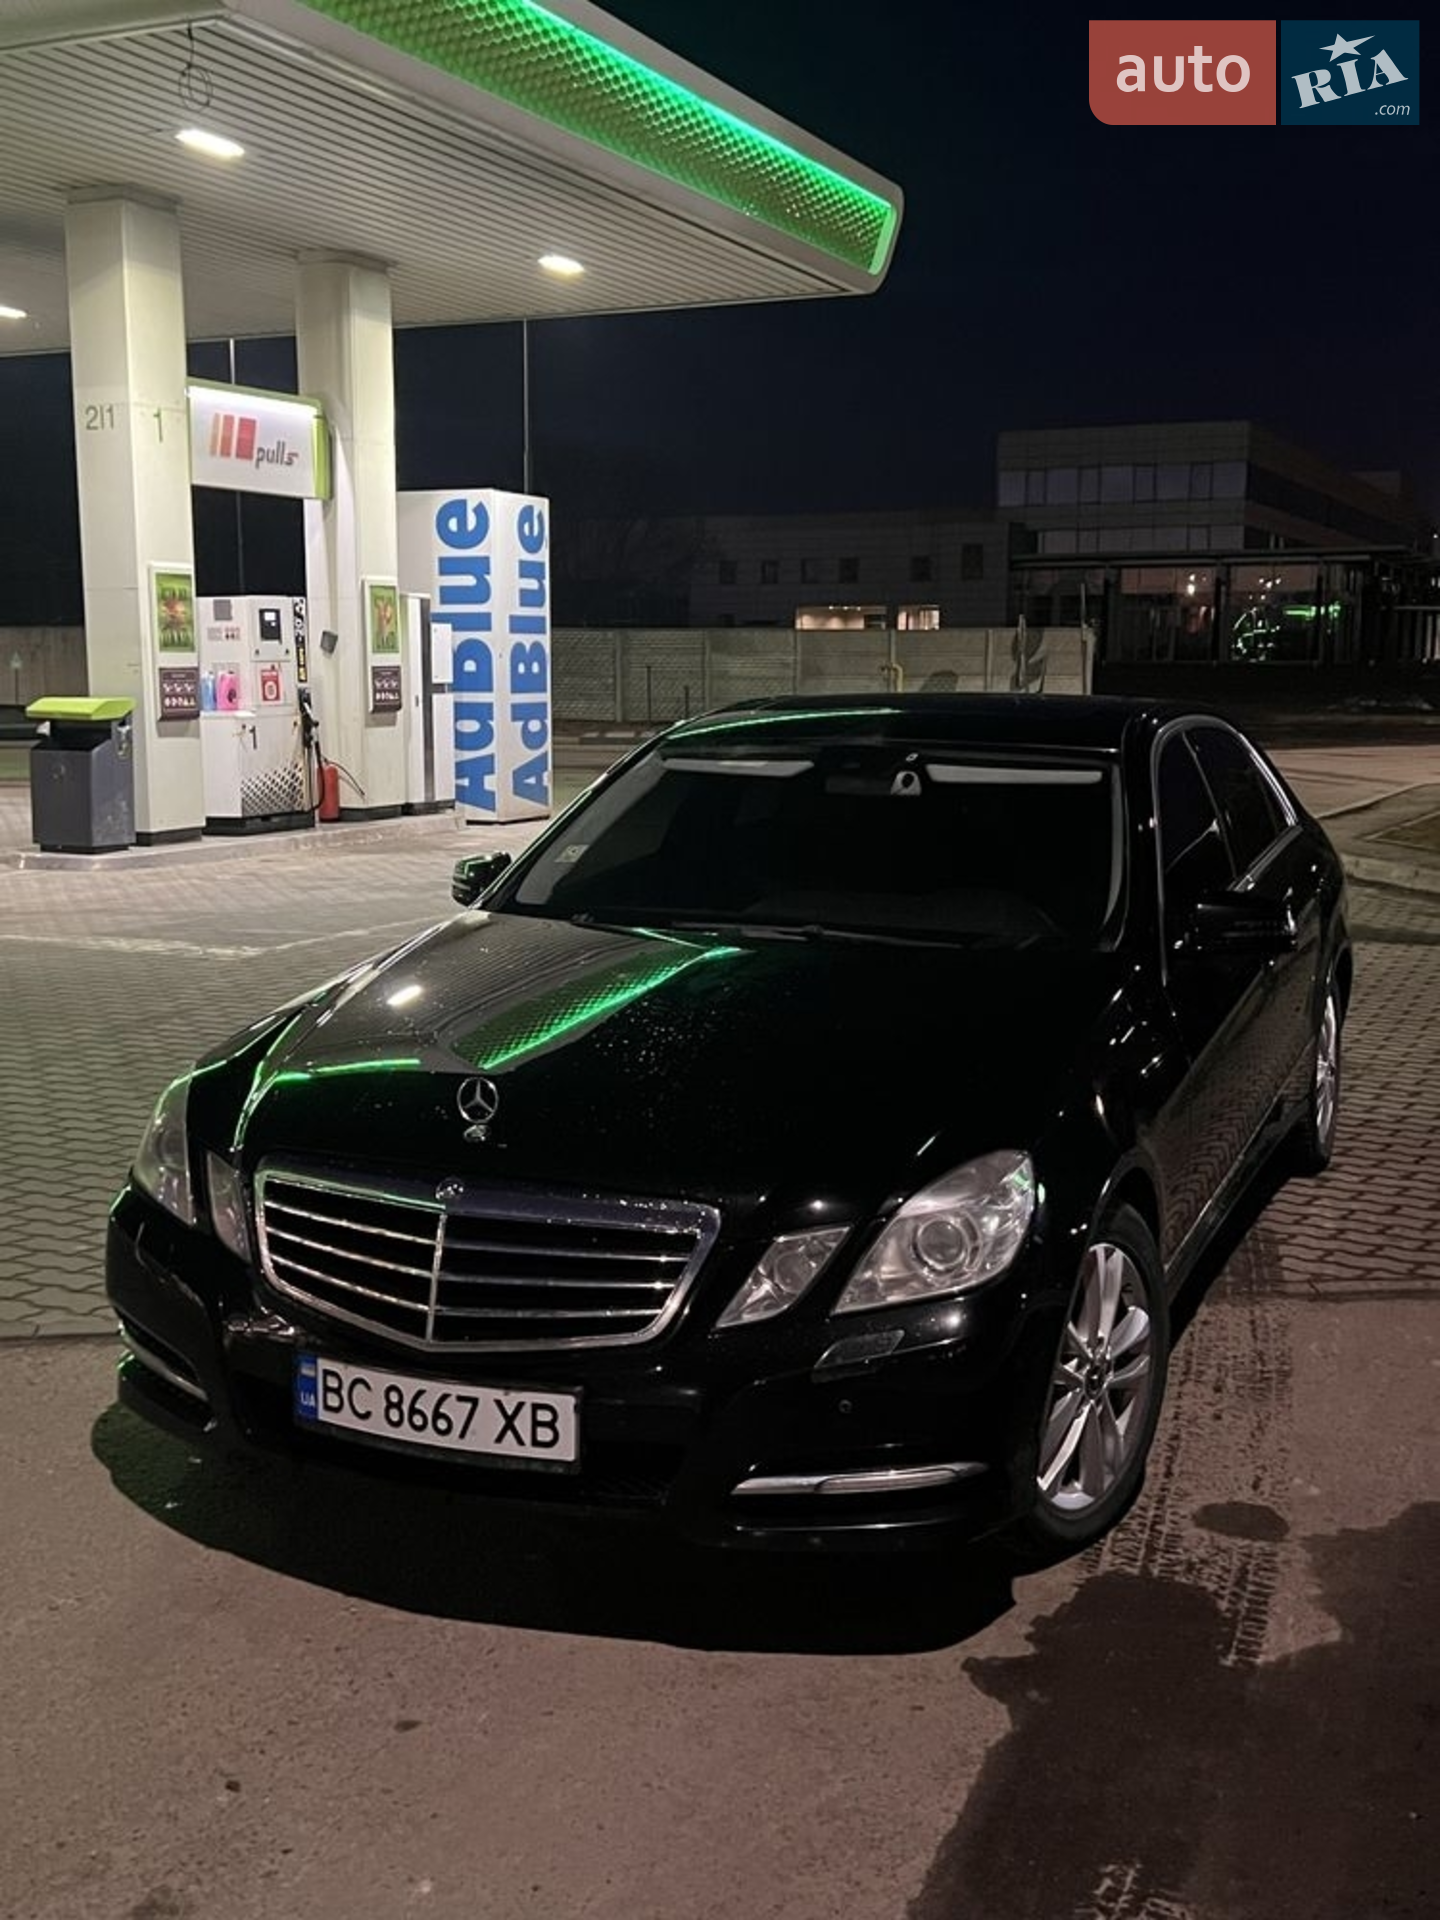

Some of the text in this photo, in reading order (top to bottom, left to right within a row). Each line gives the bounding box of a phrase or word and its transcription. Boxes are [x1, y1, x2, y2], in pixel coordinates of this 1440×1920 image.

[153, 407, 163, 442] 1
[255, 440, 299, 469] pulls
[509, 504, 548, 807] AdBlue
[301, 1391, 316, 1407] UA
[322, 1368, 560, 1449] BC 8667 XB
